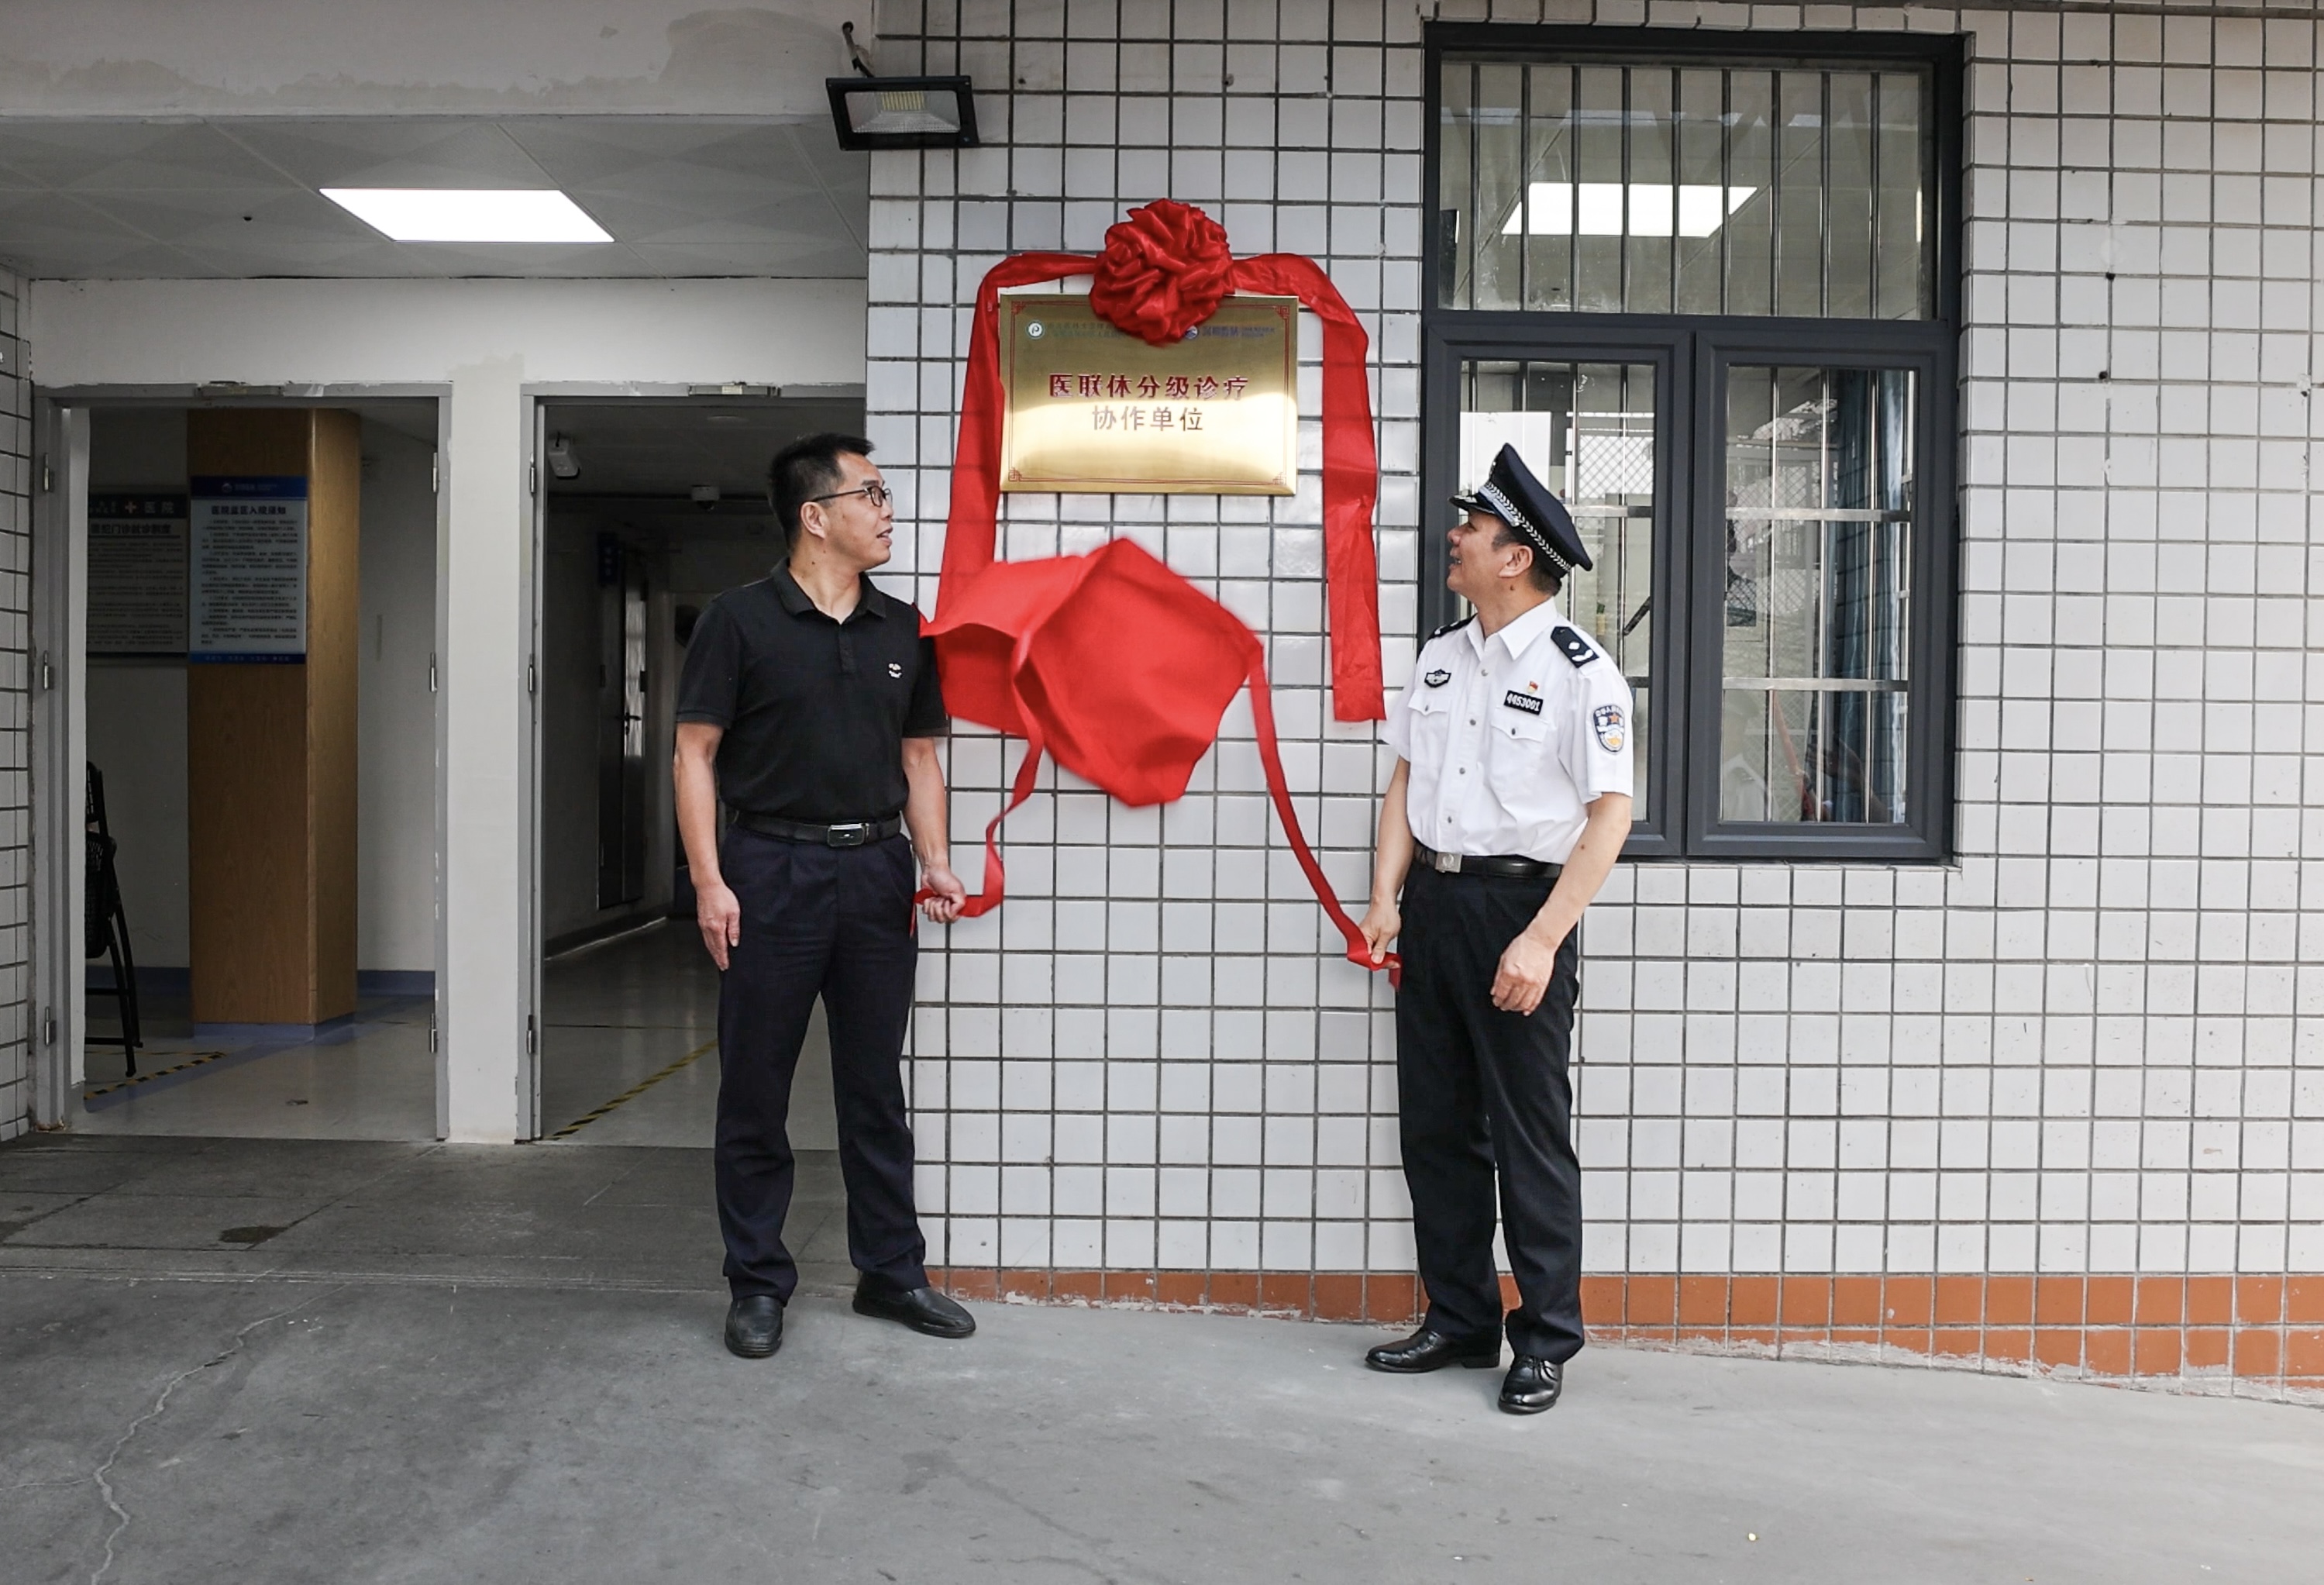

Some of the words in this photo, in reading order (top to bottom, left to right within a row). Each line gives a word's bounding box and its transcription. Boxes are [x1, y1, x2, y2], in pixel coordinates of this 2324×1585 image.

[1092, 405, 1203, 432] 协作单位
[1506, 693, 1541, 712] 4453001
